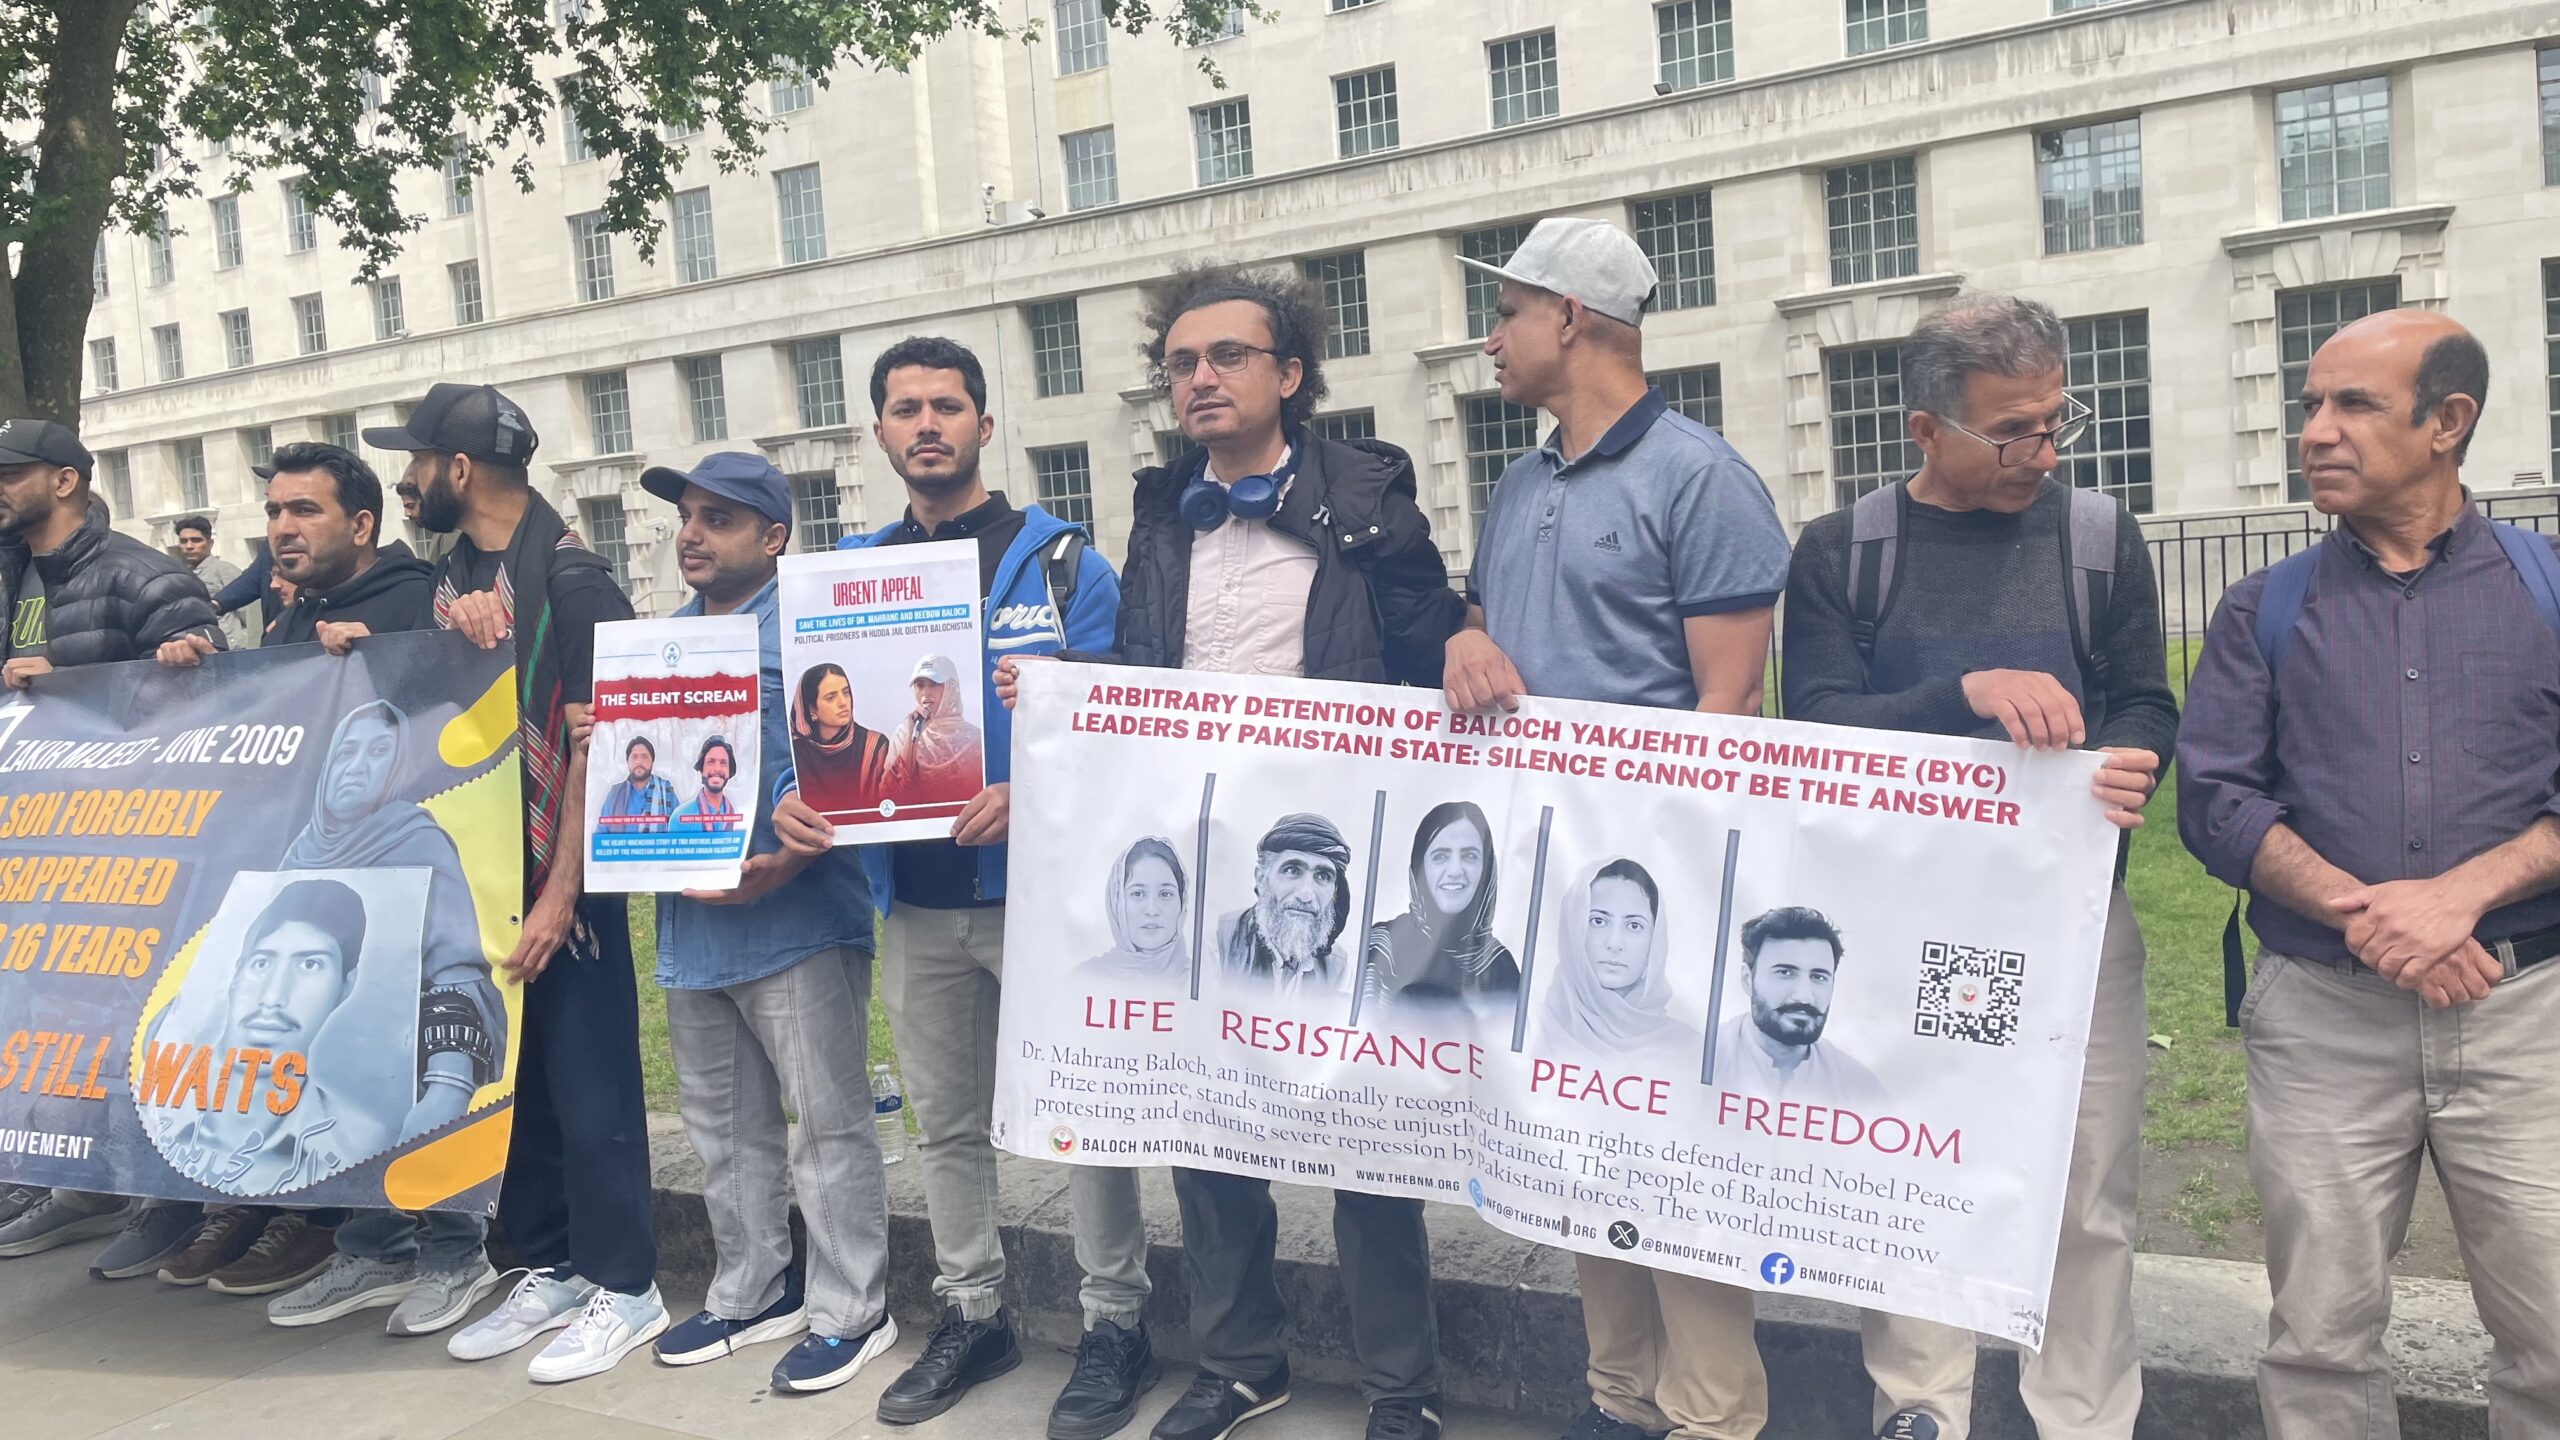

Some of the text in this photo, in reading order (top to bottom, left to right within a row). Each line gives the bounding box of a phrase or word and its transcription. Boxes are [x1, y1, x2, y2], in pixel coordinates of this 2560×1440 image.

[10, 596, 48, 649] UN
[799, 620, 816, 630] SAVE
[816, 619, 829, 628] THE
[829, 618, 847, 628] LIVES
[847, 617, 856, 626] OF
[868, 614, 899, 624] MAHRANG
[900, 611, 913, 621] AND
[942, 607, 967, 617] BALOCH
[833, 575, 923, 607] URGENT APPEAL
[794, 622, 973, 645] POLITICAL PRISONERS IN HUDDA JAIL QUETTA BALOCHISTAN
[600, 690, 747, 707] THE SILENT SCREAM
[0, 740, 76, 773] ZAKIR
[219, 724, 305, 766] 2009
[1072, 711, 2022, 827] LEADERS BY PAKISTANI STATE: SILENCE CANNOT BE THE ANSWER
[1087, 684, 2008, 795] ARBITRARY DETENTION OF BALOCH YAKJEHTI COMMITTEE (BYC)
[0, 792, 67, 839] SON
[54, 788, 223, 838] FORCIBLY
[0, 856, 178, 906] SAPPEARED
[1, 923, 47, 971] 16
[41, 924, 161, 978] YEARS
[1085, 996, 1485, 1080] LIFE RESISTANCE
[0, 1030, 307, 1117] STILL WAITS
[1022, 1040, 1975, 1216] Dr. Mahrang Baloch, an internationally recognized human rights defender and Nobel Peace
[1530, 1058, 1962, 1165] PEACE FREEDOM
[1034, 1096, 1940, 1266] protesting and enduring severe repression by Pakistani forces. The world must act now
[1049, 1069, 1926, 1234] Prize nominee, stands among those unjustly detained. The people of Balochistan are
[1081, 1137, 1138, 1155] BALOCH
[1142, 1139, 1209, 1157] NATIONAL
[1213, 1146, 1287, 1172] MOVEMENT
[1356, 1169, 1460, 1192] WWW.THEBNM.ORG
[1799, 1266, 1887, 1296] BNMOFFICIAL
